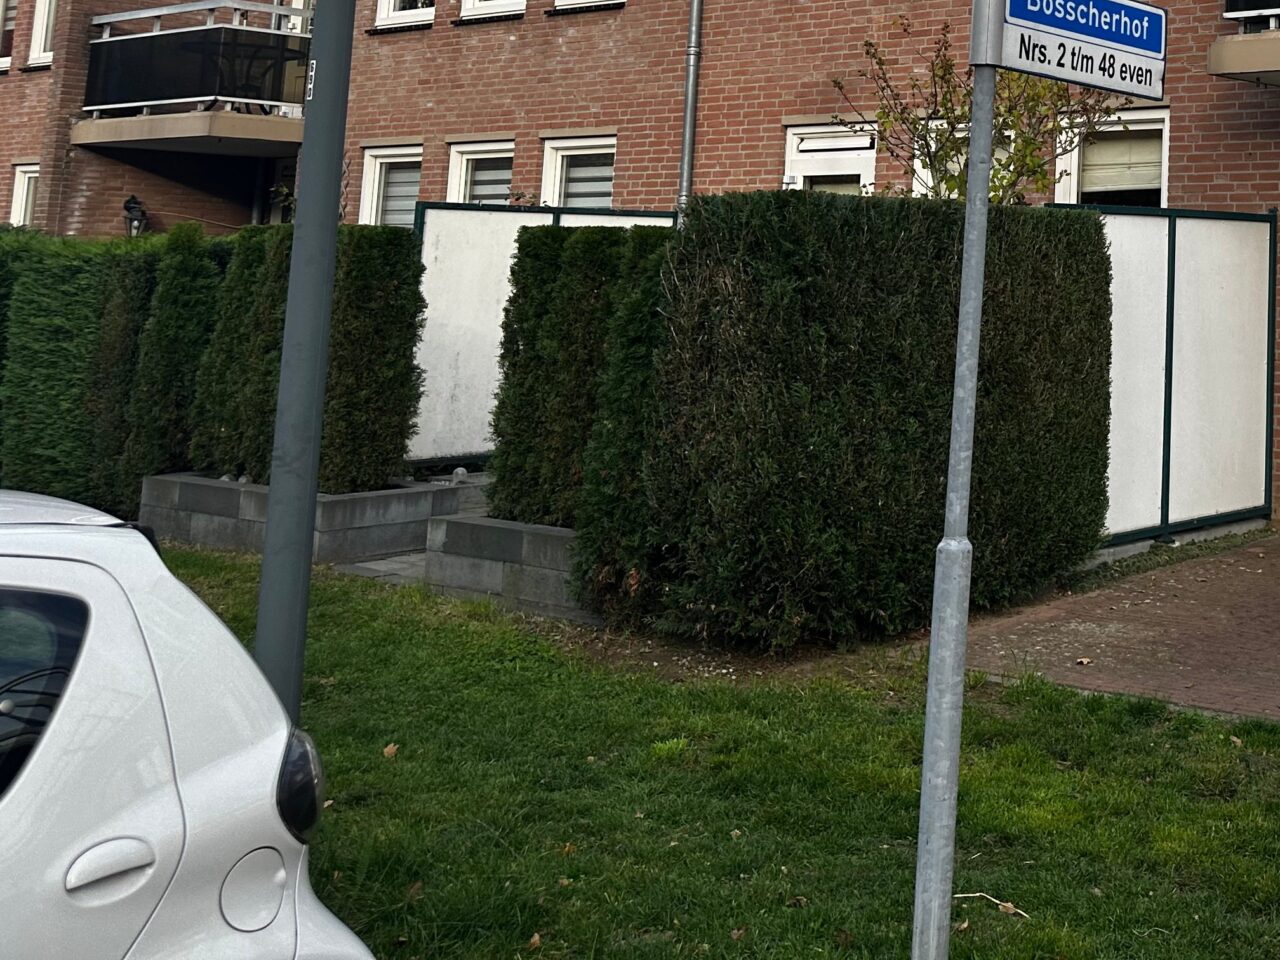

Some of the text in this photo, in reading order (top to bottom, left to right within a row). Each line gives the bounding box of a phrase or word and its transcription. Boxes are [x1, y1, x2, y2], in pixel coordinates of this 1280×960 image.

[1018, 33, 1153, 87] Nrs. 2 t/m 48 even
